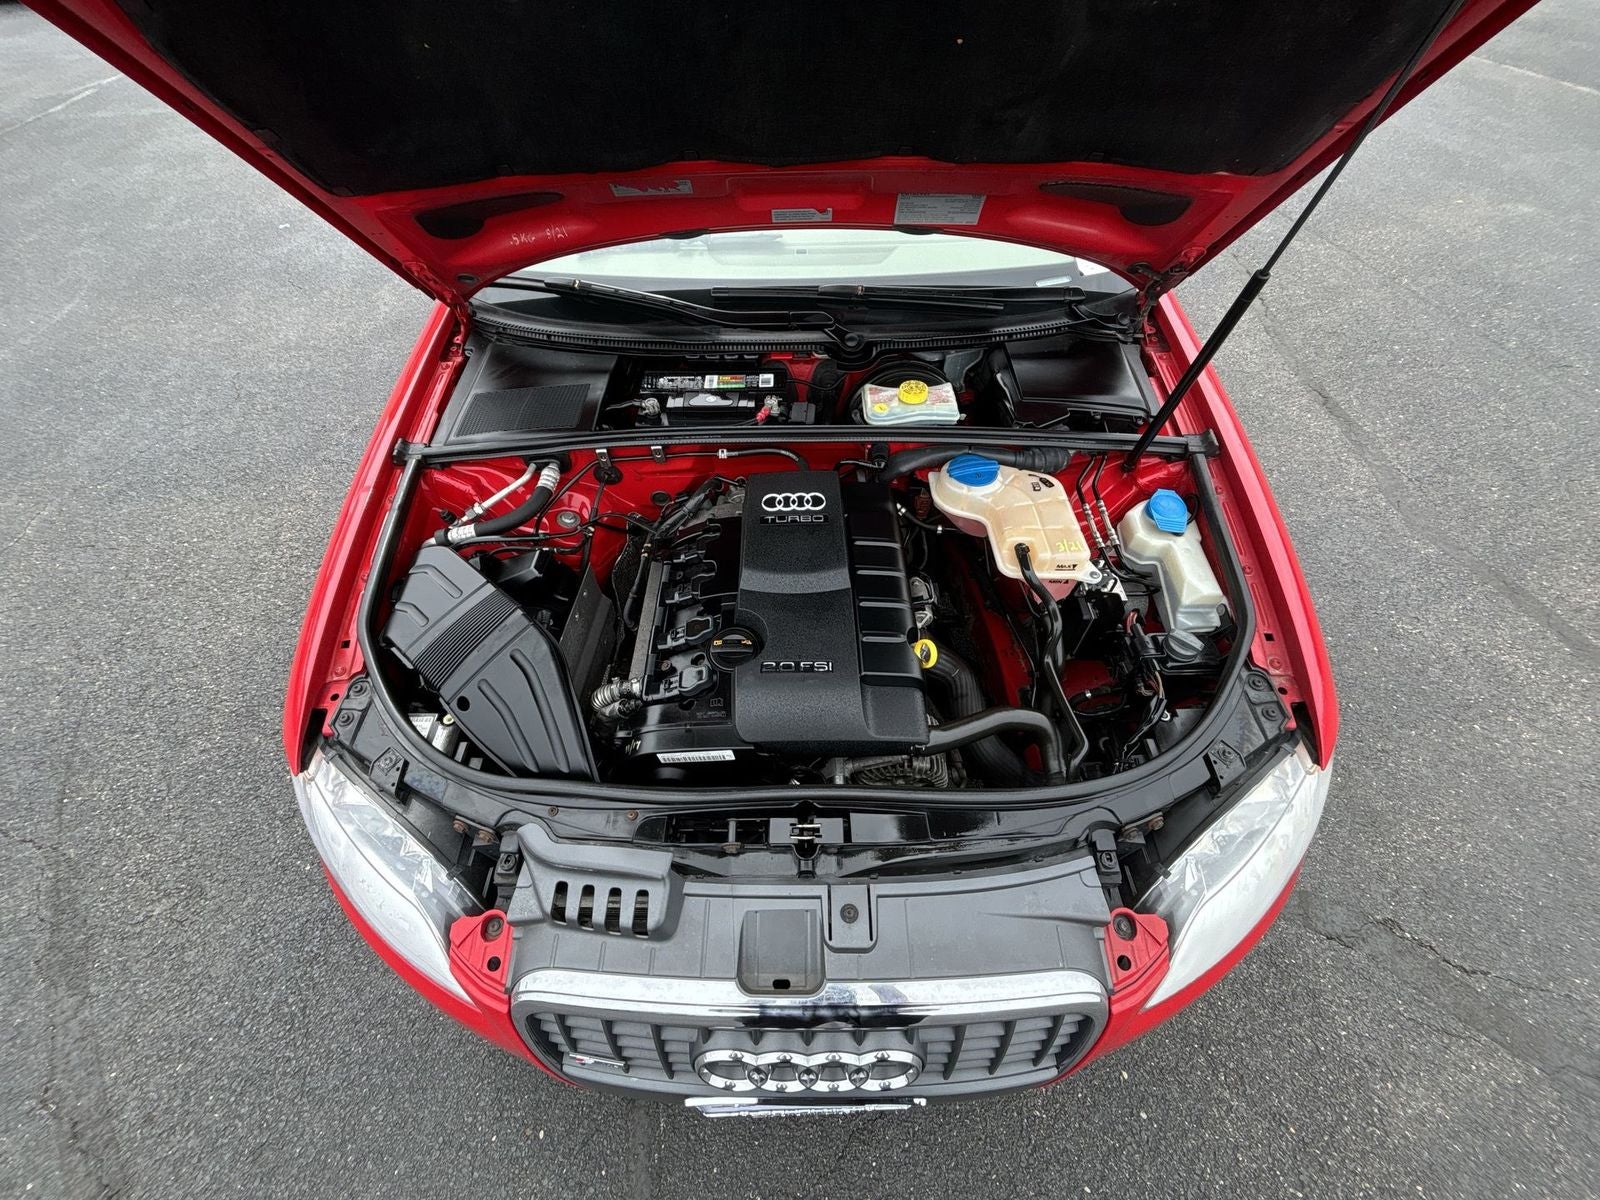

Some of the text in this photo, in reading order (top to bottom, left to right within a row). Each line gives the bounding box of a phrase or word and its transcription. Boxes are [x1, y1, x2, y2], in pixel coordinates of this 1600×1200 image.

[764, 514, 824, 523] TURBO
[761, 661, 832, 672] 2.0 FSI
